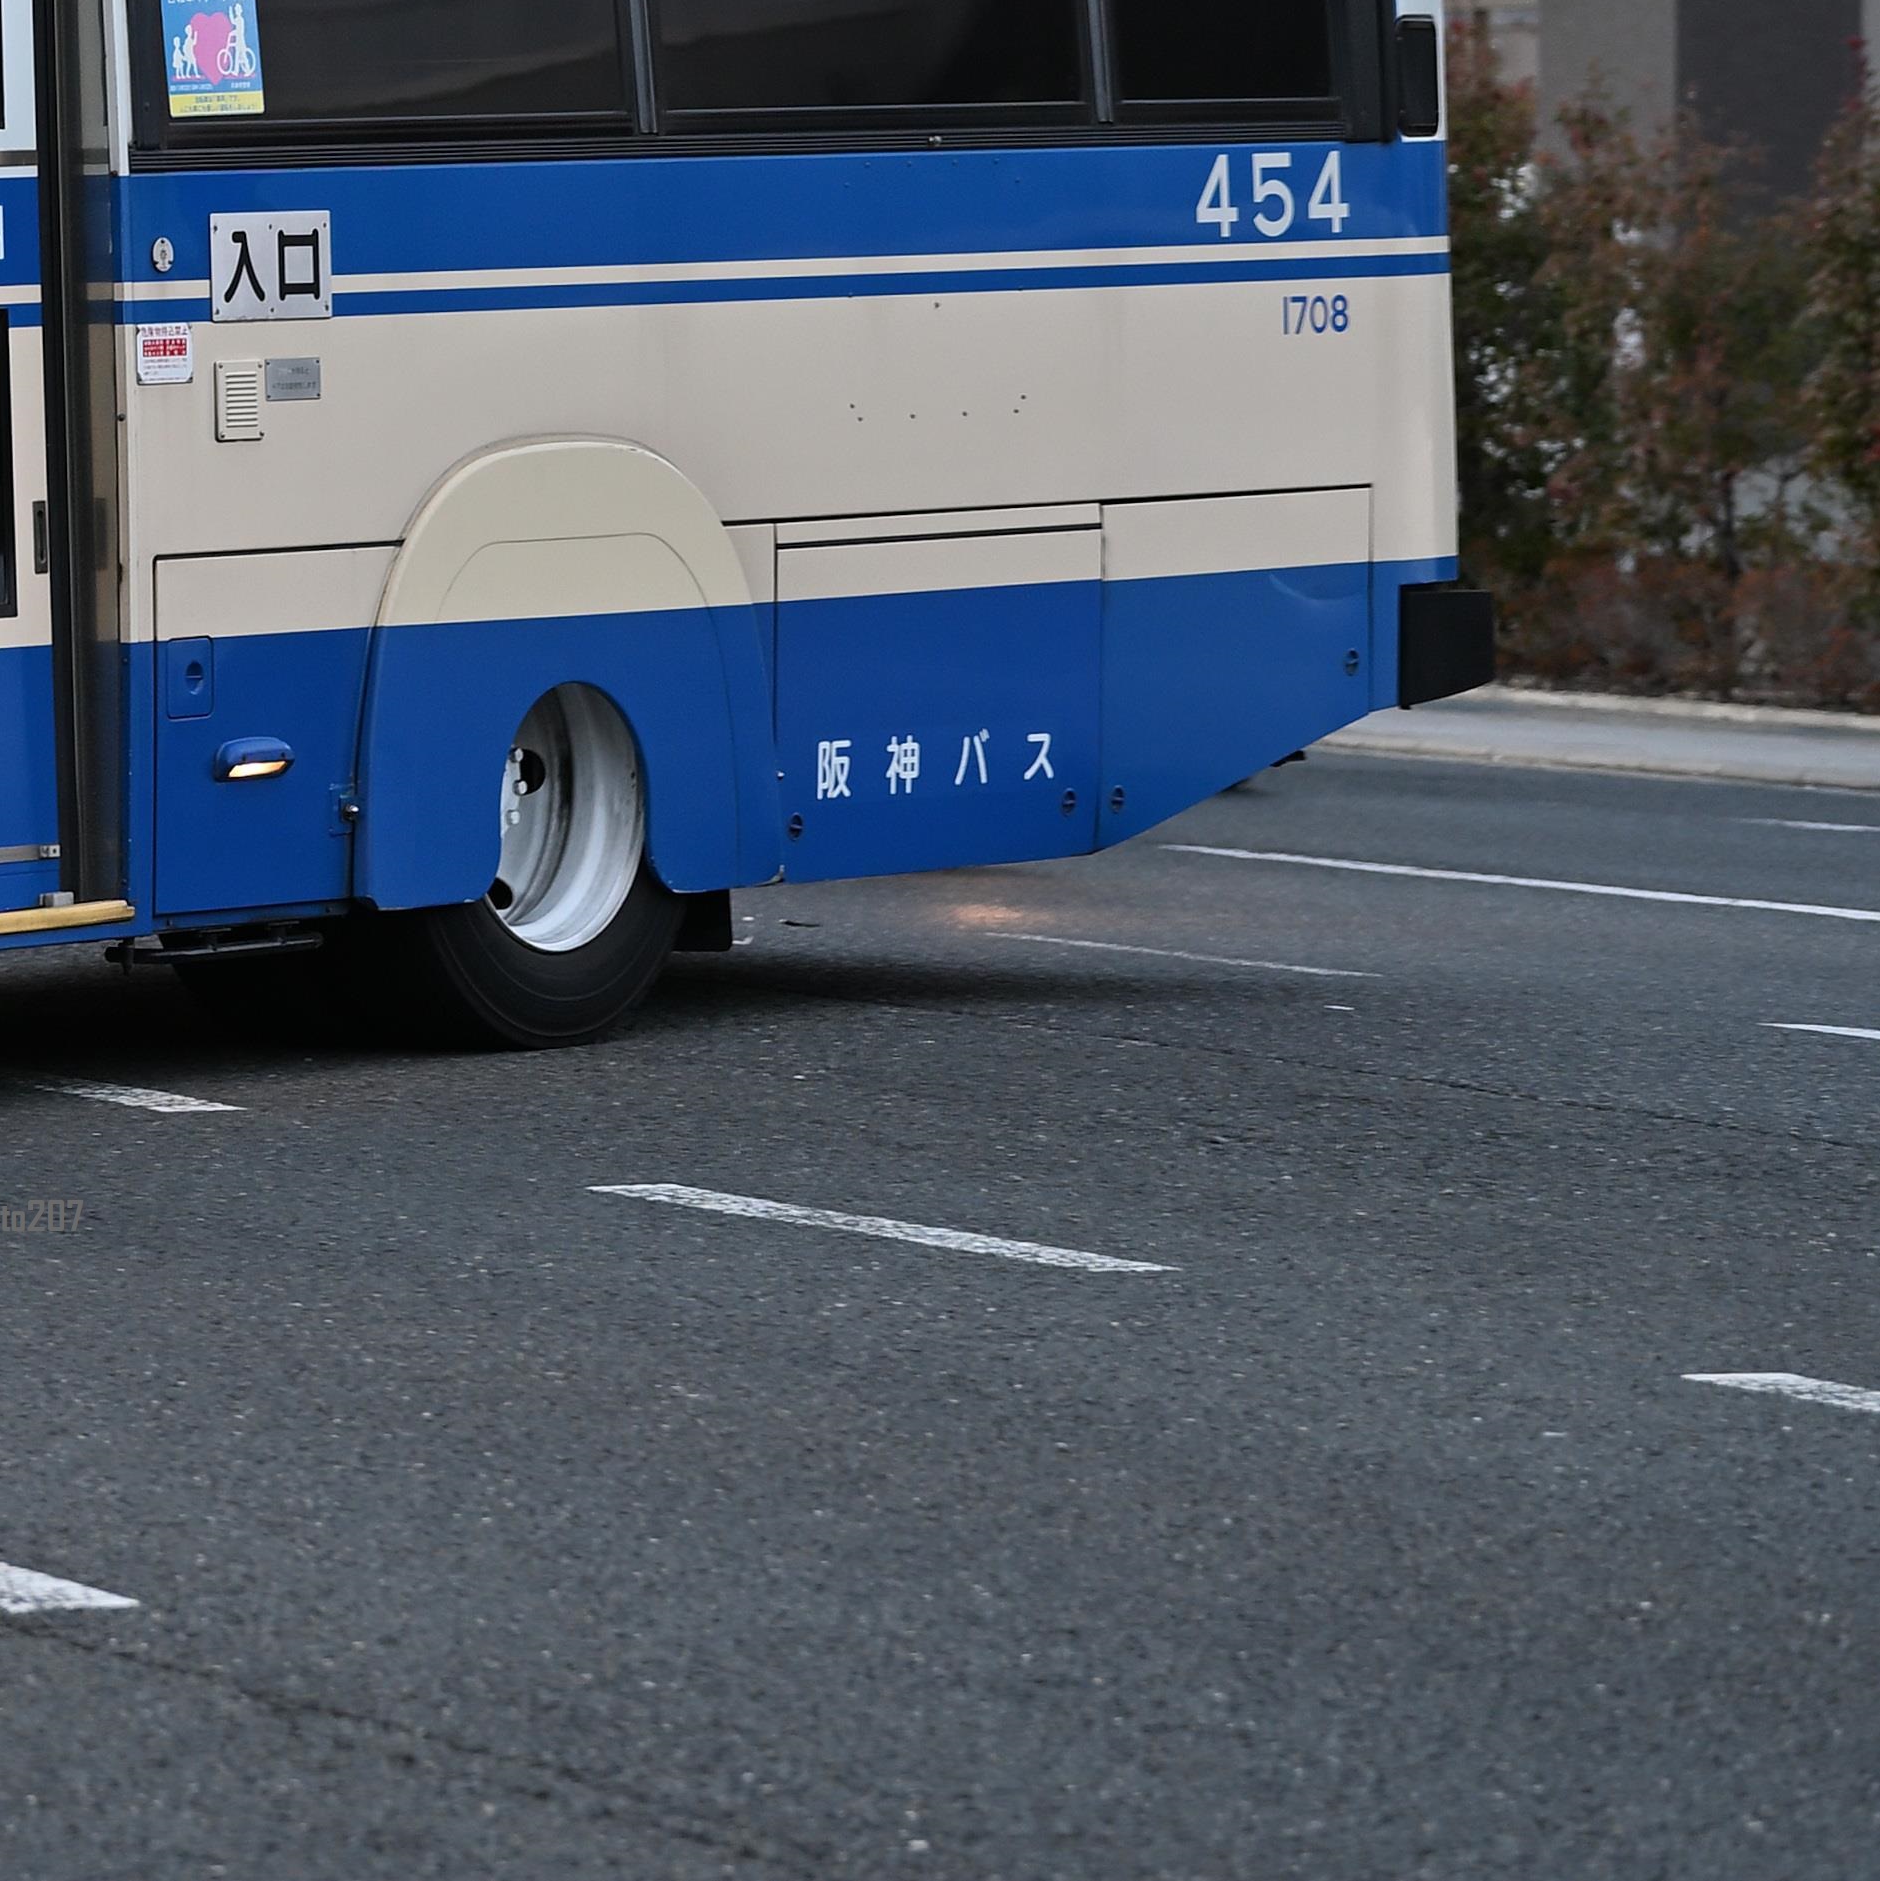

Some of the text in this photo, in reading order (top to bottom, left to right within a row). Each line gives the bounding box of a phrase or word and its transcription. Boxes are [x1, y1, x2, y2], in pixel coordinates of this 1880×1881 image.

[1195, 150, 1351, 248] 454
[224, 227, 321, 304] 入口
[1283, 294, 1350, 336] 1708
[816, 727, 1055, 801] 阪神バス
